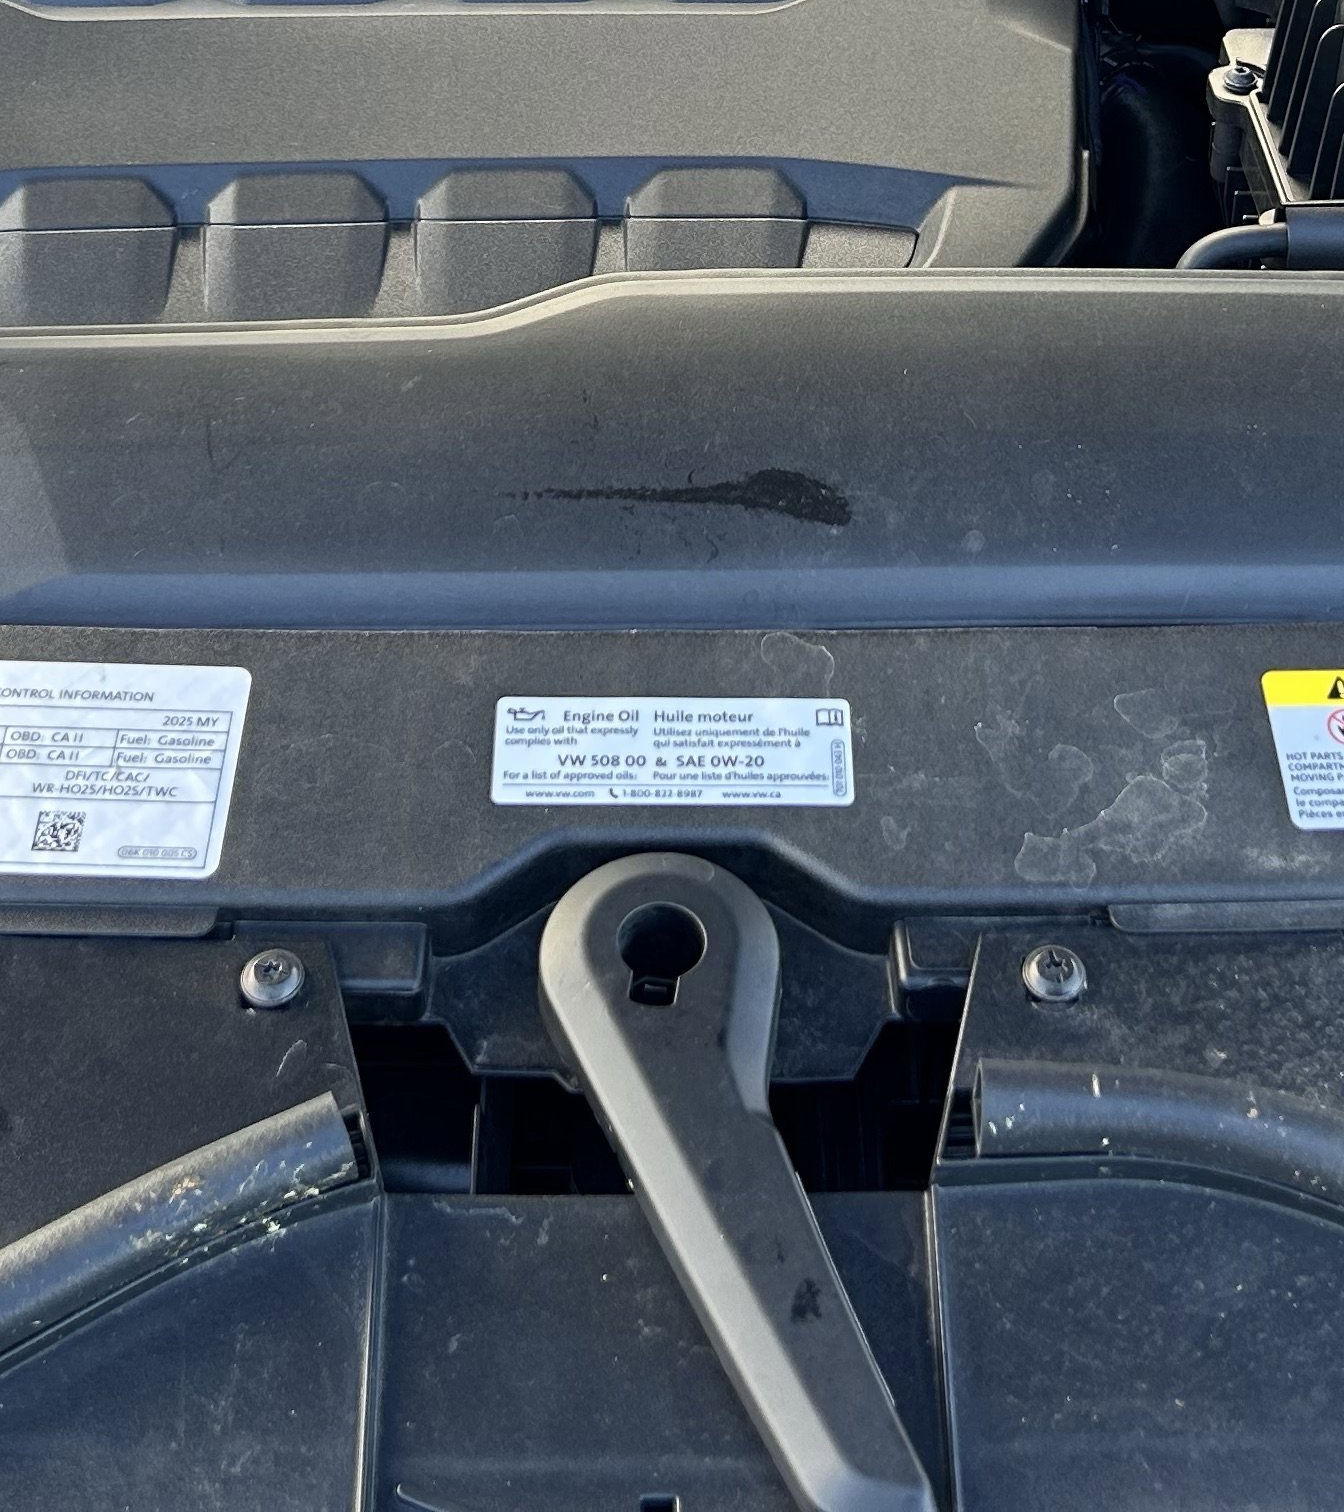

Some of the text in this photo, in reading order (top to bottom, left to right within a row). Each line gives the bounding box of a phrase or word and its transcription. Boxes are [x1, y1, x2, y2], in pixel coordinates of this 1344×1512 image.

[59, 690, 154, 702] INFORMATION
[564, 709, 639, 724] Engine Oil
[654, 710, 753, 722] Huile moteur
[162, 716, 219, 727] 2025 MY
[506, 725, 638, 736] Use only oil that expressly
[654, 728, 692, 736] Utilisez
[695, 728, 760, 738] uniquement
[763, 728, 775, 736] de
[51, 733, 71, 742] CA
[119, 734, 214, 746] Fuel: Gasoline
[505, 737, 551, 747] complies
[654, 739, 670, 748] qui
[673, 739, 714, 748] satisfait
[47, 750, 67, 760] CA
[116, 752, 211, 764] Fuel: Gasoline
[1286, 752, 1306, 760] HOT
[1311, 752, 1343, 760] PARTS
[558, 754, 765, 767] VW 508 00 & SAE 0W-20
[504, 771, 520, 779] For
[532, 771, 547, 779] list
[550, 770, 561, 779] of
[563, 771, 613, 781] approved
[653, 772, 677, 780] Pour
[702, 772, 722, 781] liste
[725, 772, 764, 781] d'huiles
[1291, 773, 1334, 781] MOVING
[526, 790, 594, 798] www.vw.com
[1297, 798, 1305, 806] le
[1299, 809, 1332, 818] Pièces
